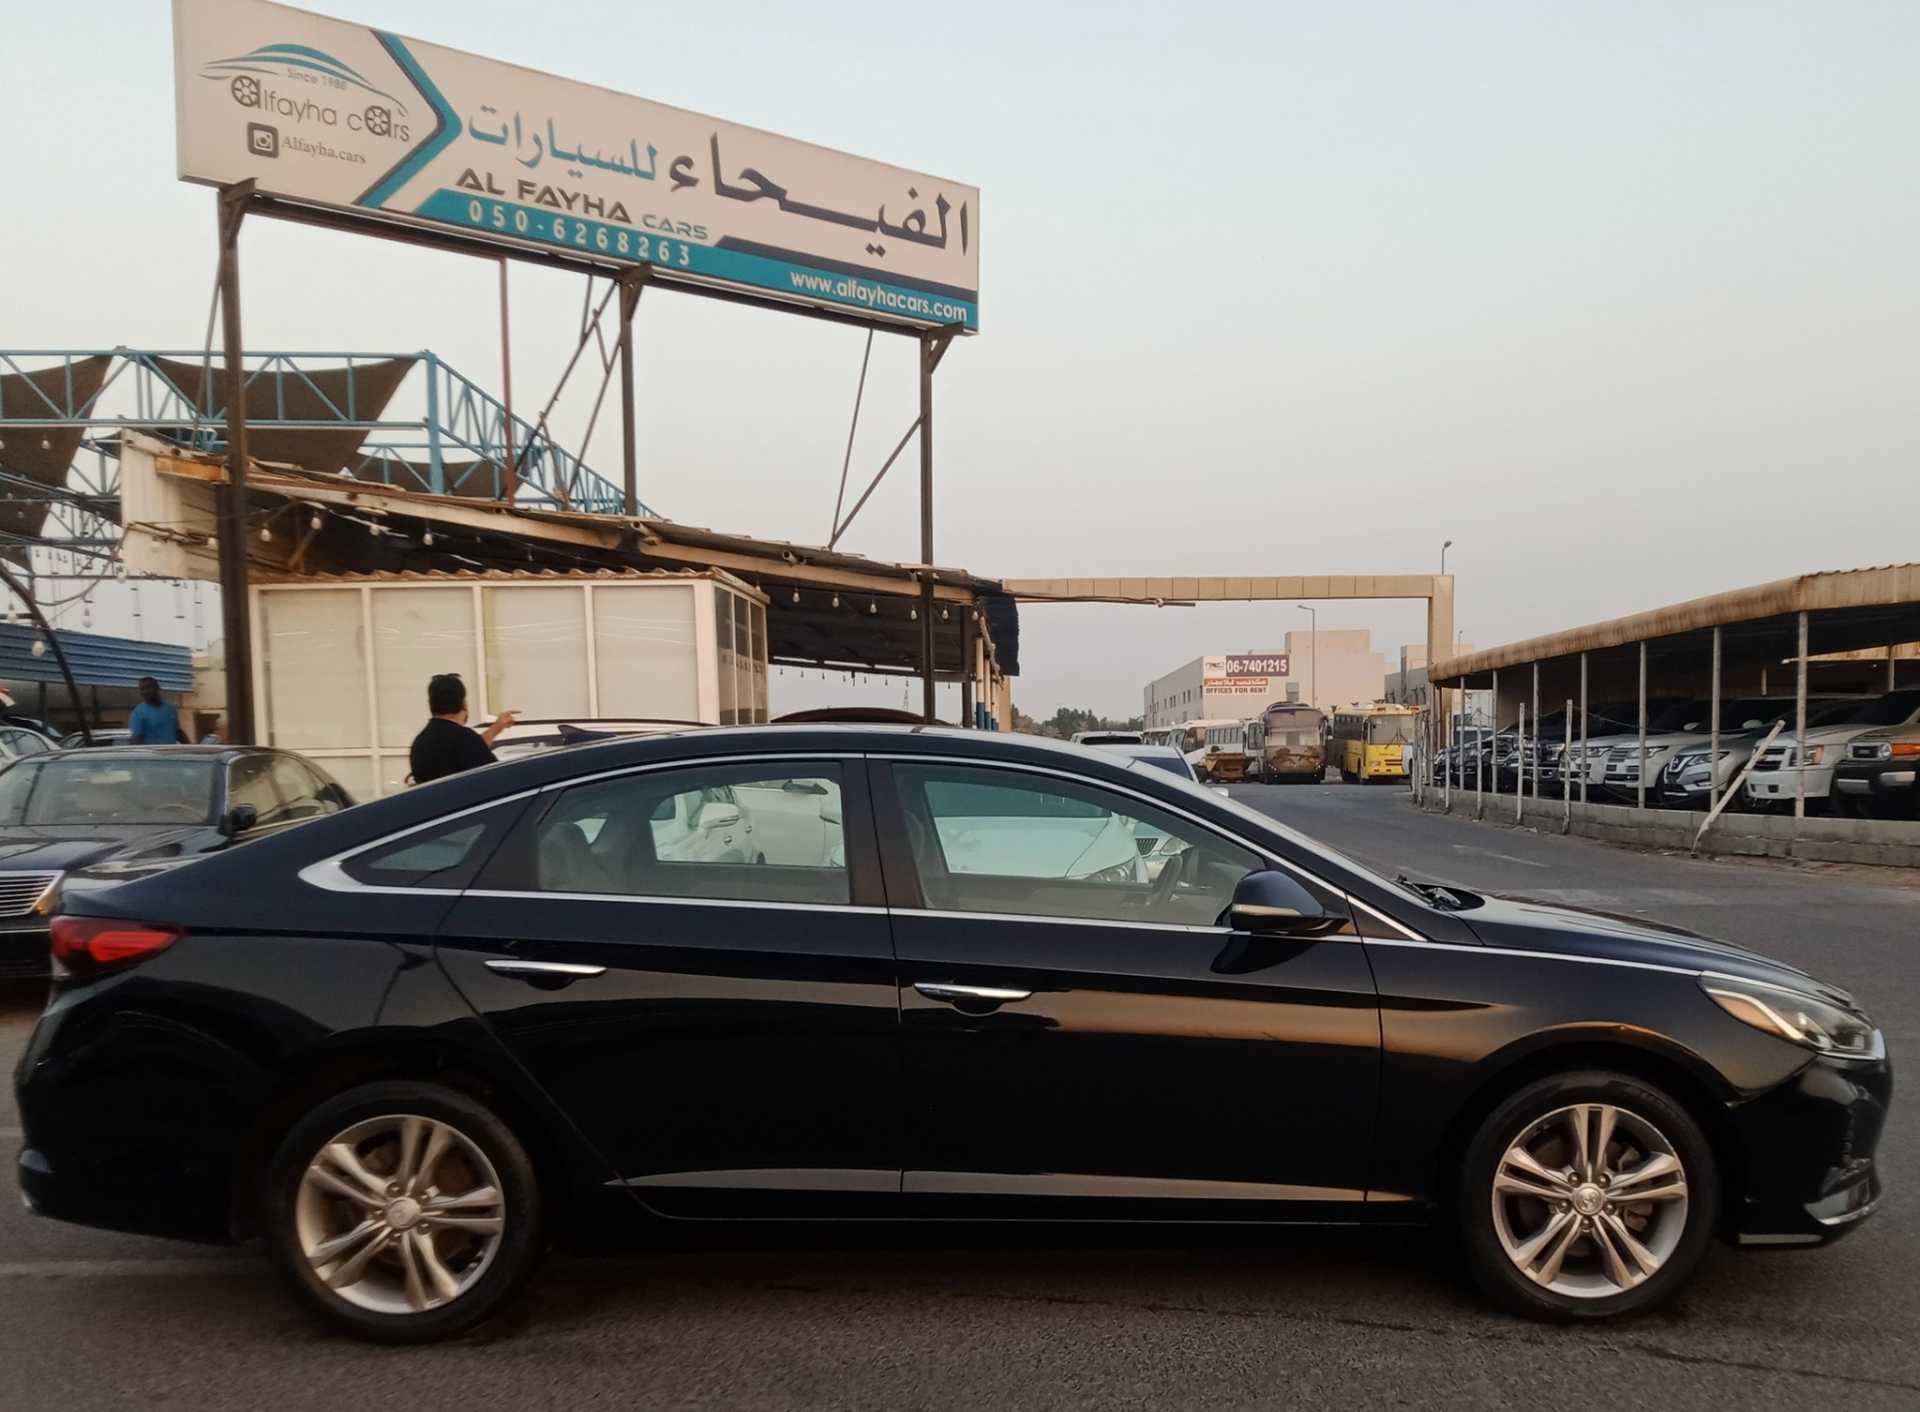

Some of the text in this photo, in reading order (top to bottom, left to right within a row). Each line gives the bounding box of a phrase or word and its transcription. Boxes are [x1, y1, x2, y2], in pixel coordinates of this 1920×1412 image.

[287, 68, 317, 85] Since
[282, 136, 366, 164] Alfayha.cars
[469, 104, 969, 258] الفيحاء للسيارات
[456, 167, 709, 240] AL FAYHA CARS
[790, 271, 968, 322] www.alfayhacars.com
[1227, 659, 1287, 673] 06-7401215
